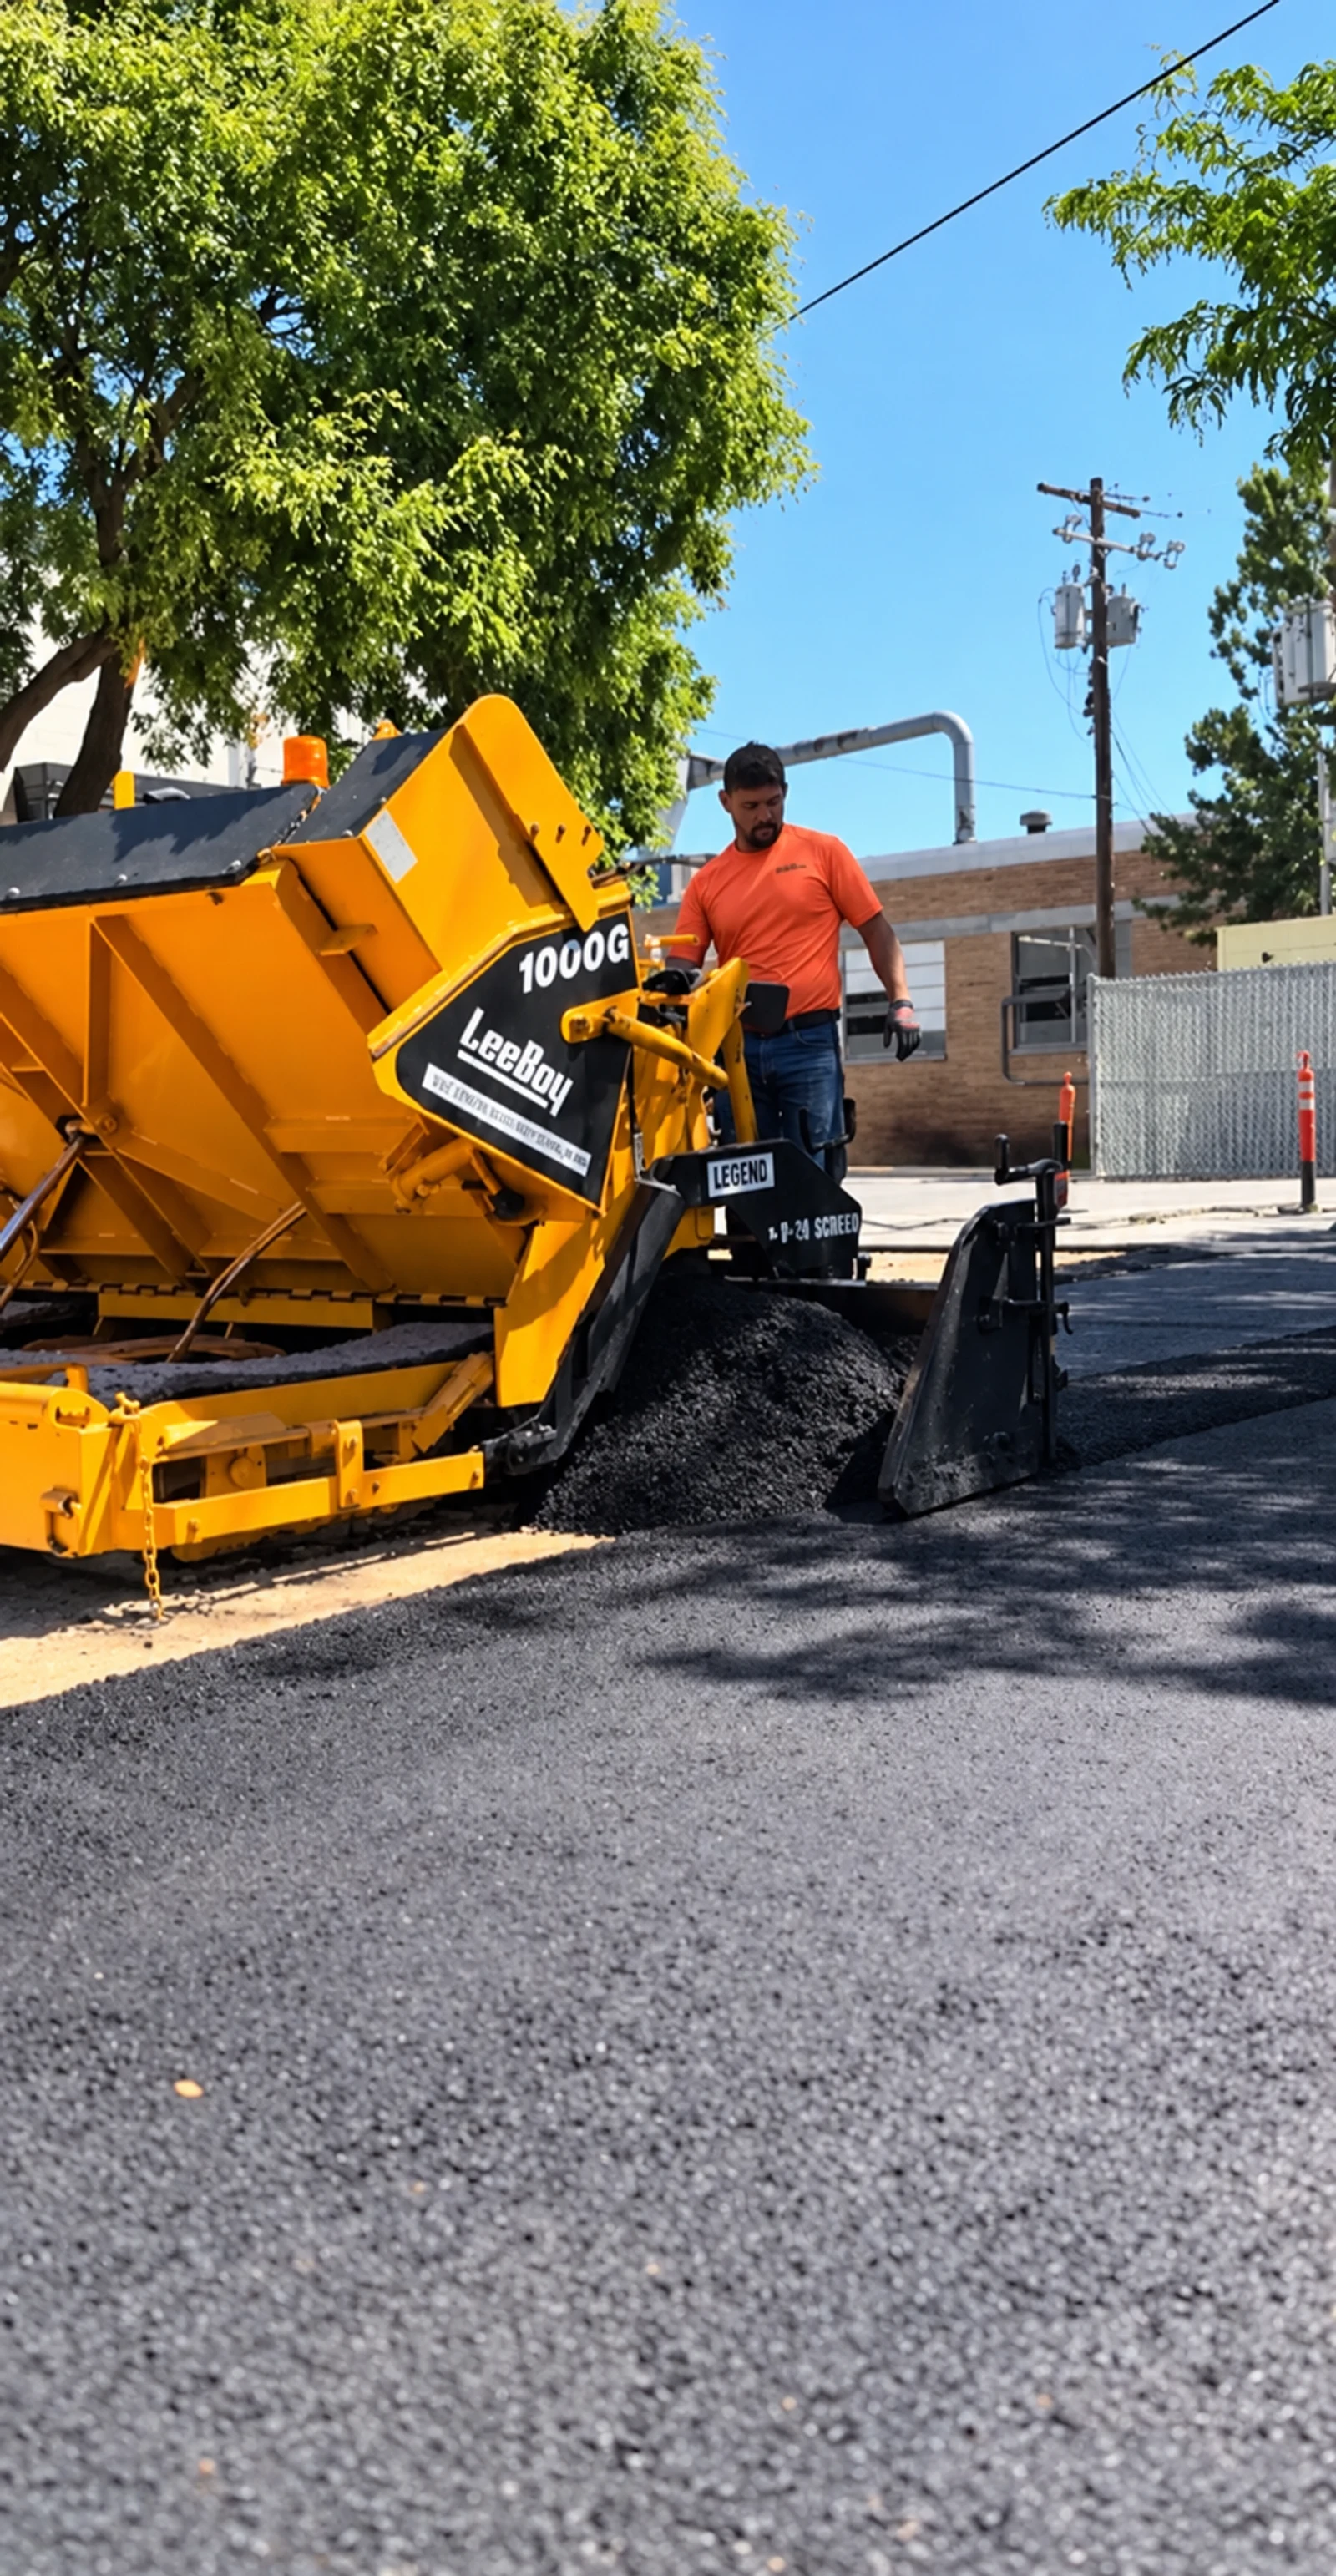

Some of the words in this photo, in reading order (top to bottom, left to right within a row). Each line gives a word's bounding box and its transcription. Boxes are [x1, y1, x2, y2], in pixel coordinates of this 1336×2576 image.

[519, 923, 630, 994] 1000G
[459, 1006, 574, 1118] LeeBoy
[713, 1159, 768, 1189] LEGEND
